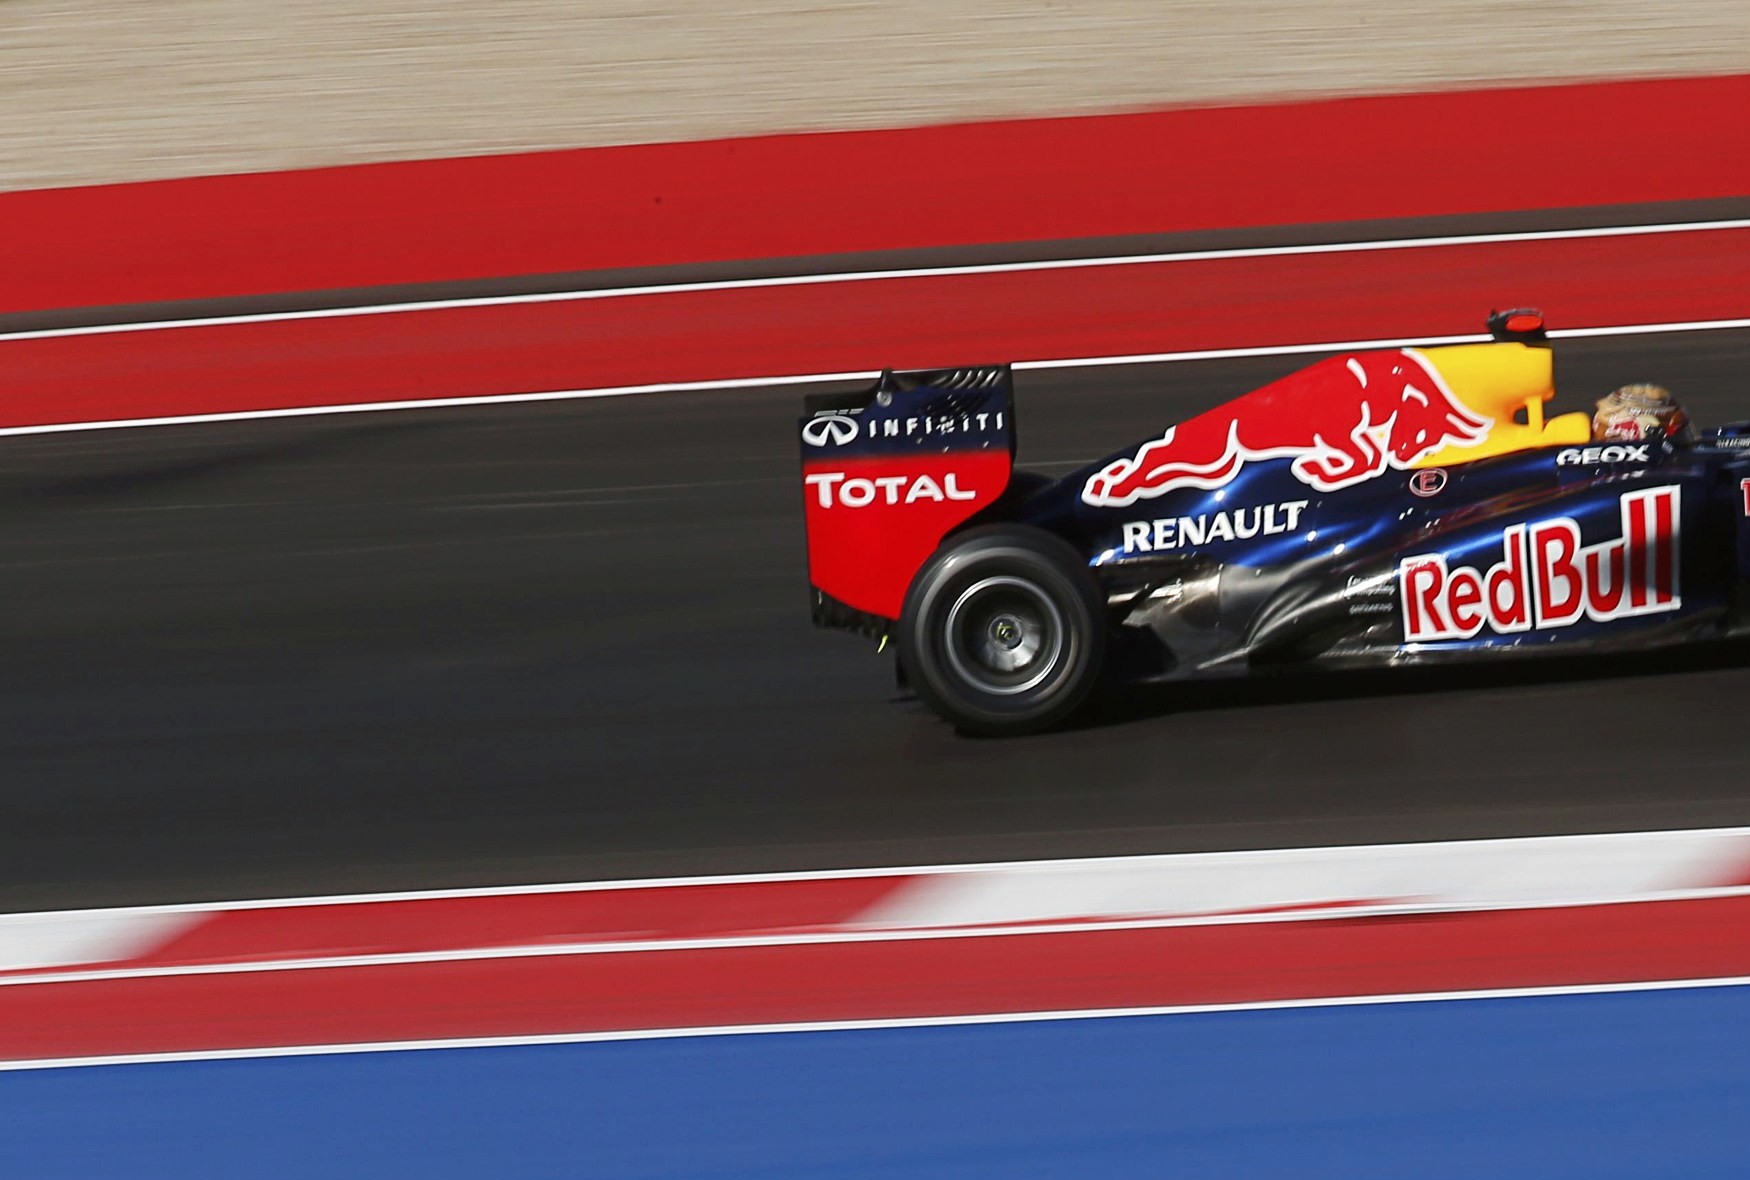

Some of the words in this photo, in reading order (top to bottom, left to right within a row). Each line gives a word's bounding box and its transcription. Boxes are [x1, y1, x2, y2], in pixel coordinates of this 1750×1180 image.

[1556, 444, 1650, 466] GEOX
[805, 472, 976, 509] TOTAL
[1123, 500, 1309, 554] RENAULT
